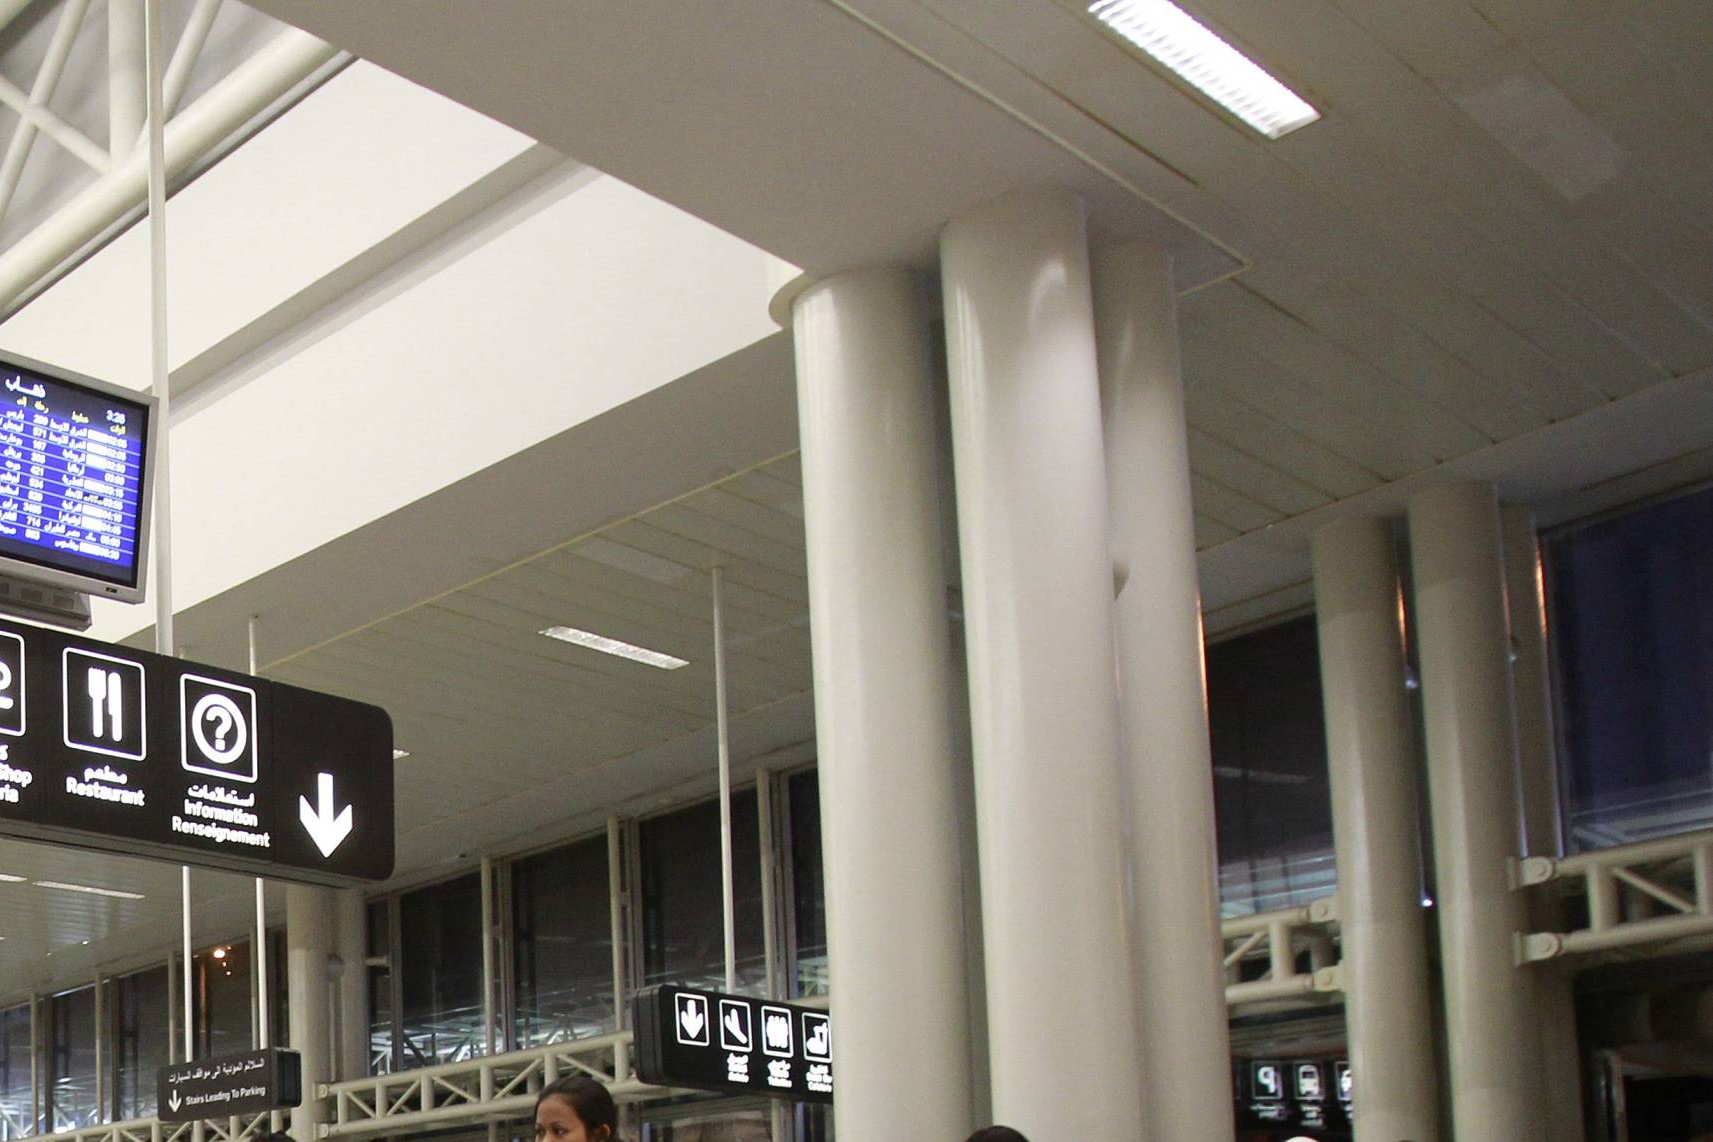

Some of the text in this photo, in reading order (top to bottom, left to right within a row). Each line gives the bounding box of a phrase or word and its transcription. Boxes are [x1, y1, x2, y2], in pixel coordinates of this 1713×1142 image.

[84, 763, 128, 785] مطعم
[65, 776, 145, 807] Restaurant
[187, 783, 256, 808] استعلامات
[184, 799, 259, 828] Information
[171, 814, 271, 849] Renseignement
[186, 1085, 266, 1106] Stairs Leading To Parking
